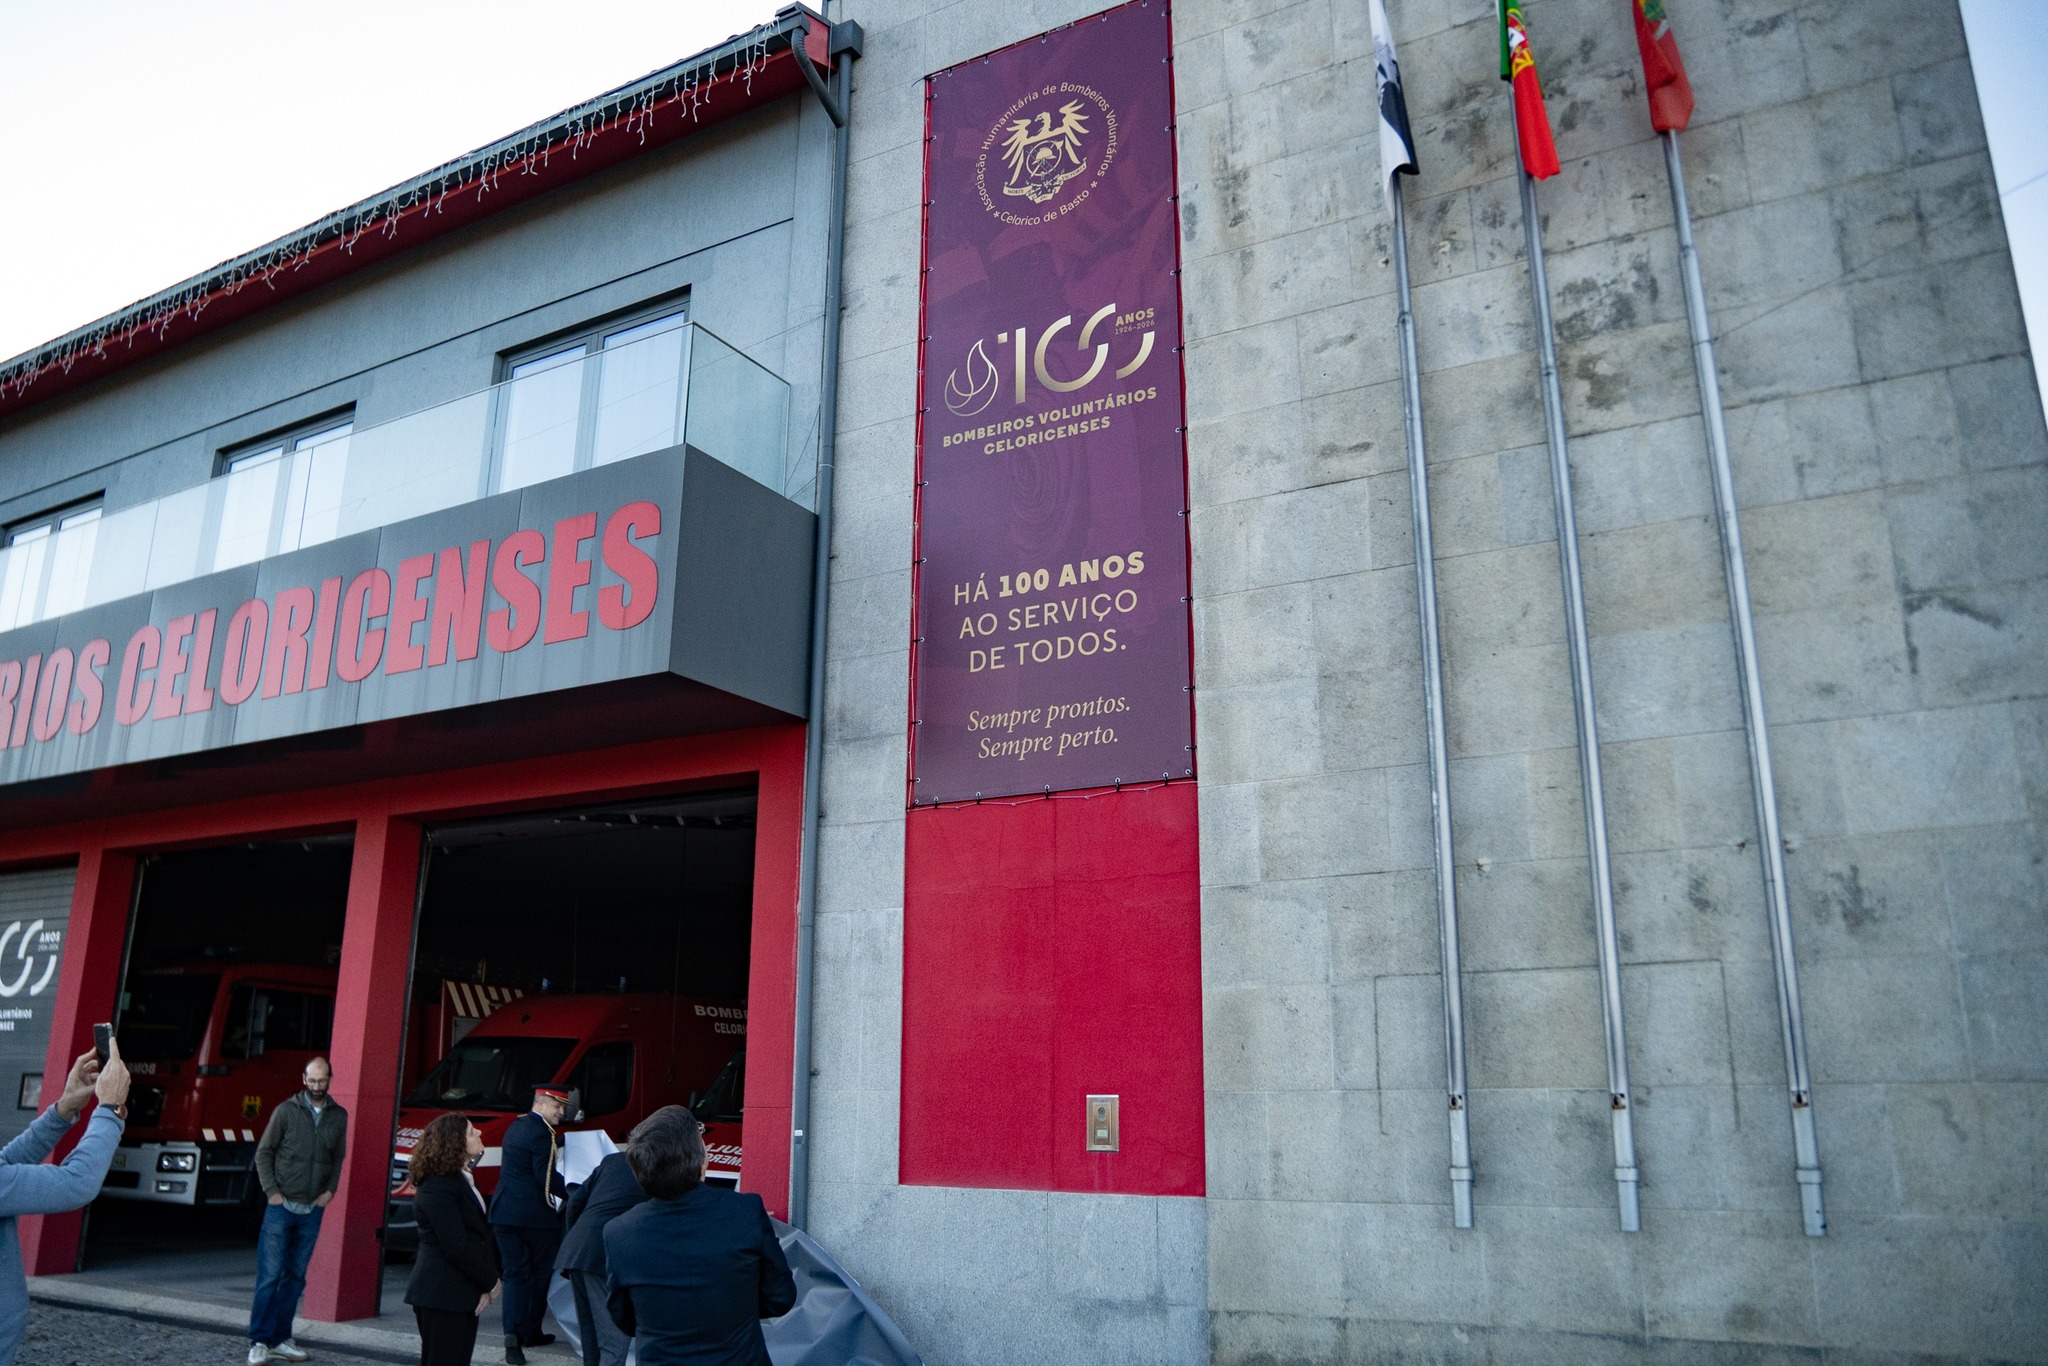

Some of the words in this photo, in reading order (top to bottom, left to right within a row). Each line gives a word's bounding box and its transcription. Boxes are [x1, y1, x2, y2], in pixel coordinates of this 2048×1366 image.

[1042, 85, 1057, 96] de
[1060, 82, 1110, 111] Bombeiros
[981, 91, 1039, 150] Humanitária
[1097, 109, 1119, 177] Voluntários
[975, 153, 995, 211] Associação
[1000, 211, 1041, 226] Celorico
[1043, 211, 1058, 223] de
[1059, 189, 1090, 215] Basto
[1115, 307, 1155, 327] ANOS
[1115, 319, 1155, 335] 1926-2026
[943, 415, 1035, 448] BOMBEIROS
[1038, 386, 1157, 425] VOLUNTÁRIOS
[983, 415, 1111, 455] CELORICENSES
[954, 572, 989, 605] HÁ
[999, 568, 1050, 598] 100
[1058, 551, 1145, 587] ANOS
[114, 501, 662, 726] CELORICENSES
[959, 612, 999, 639] AO
[1007, 589, 1138, 632] SERVIÇO
[969, 646, 1006, 673] DE
[1014, 628, 1127, 665] TODOS.
[967, 708, 1041, 733] Sempre
[1045, 696, 1131, 728] prontos.
[978, 735, 1053, 761] Sempre
[1056, 725, 1119, 756] perto.
[39, 931, 61, 943] ANOS
